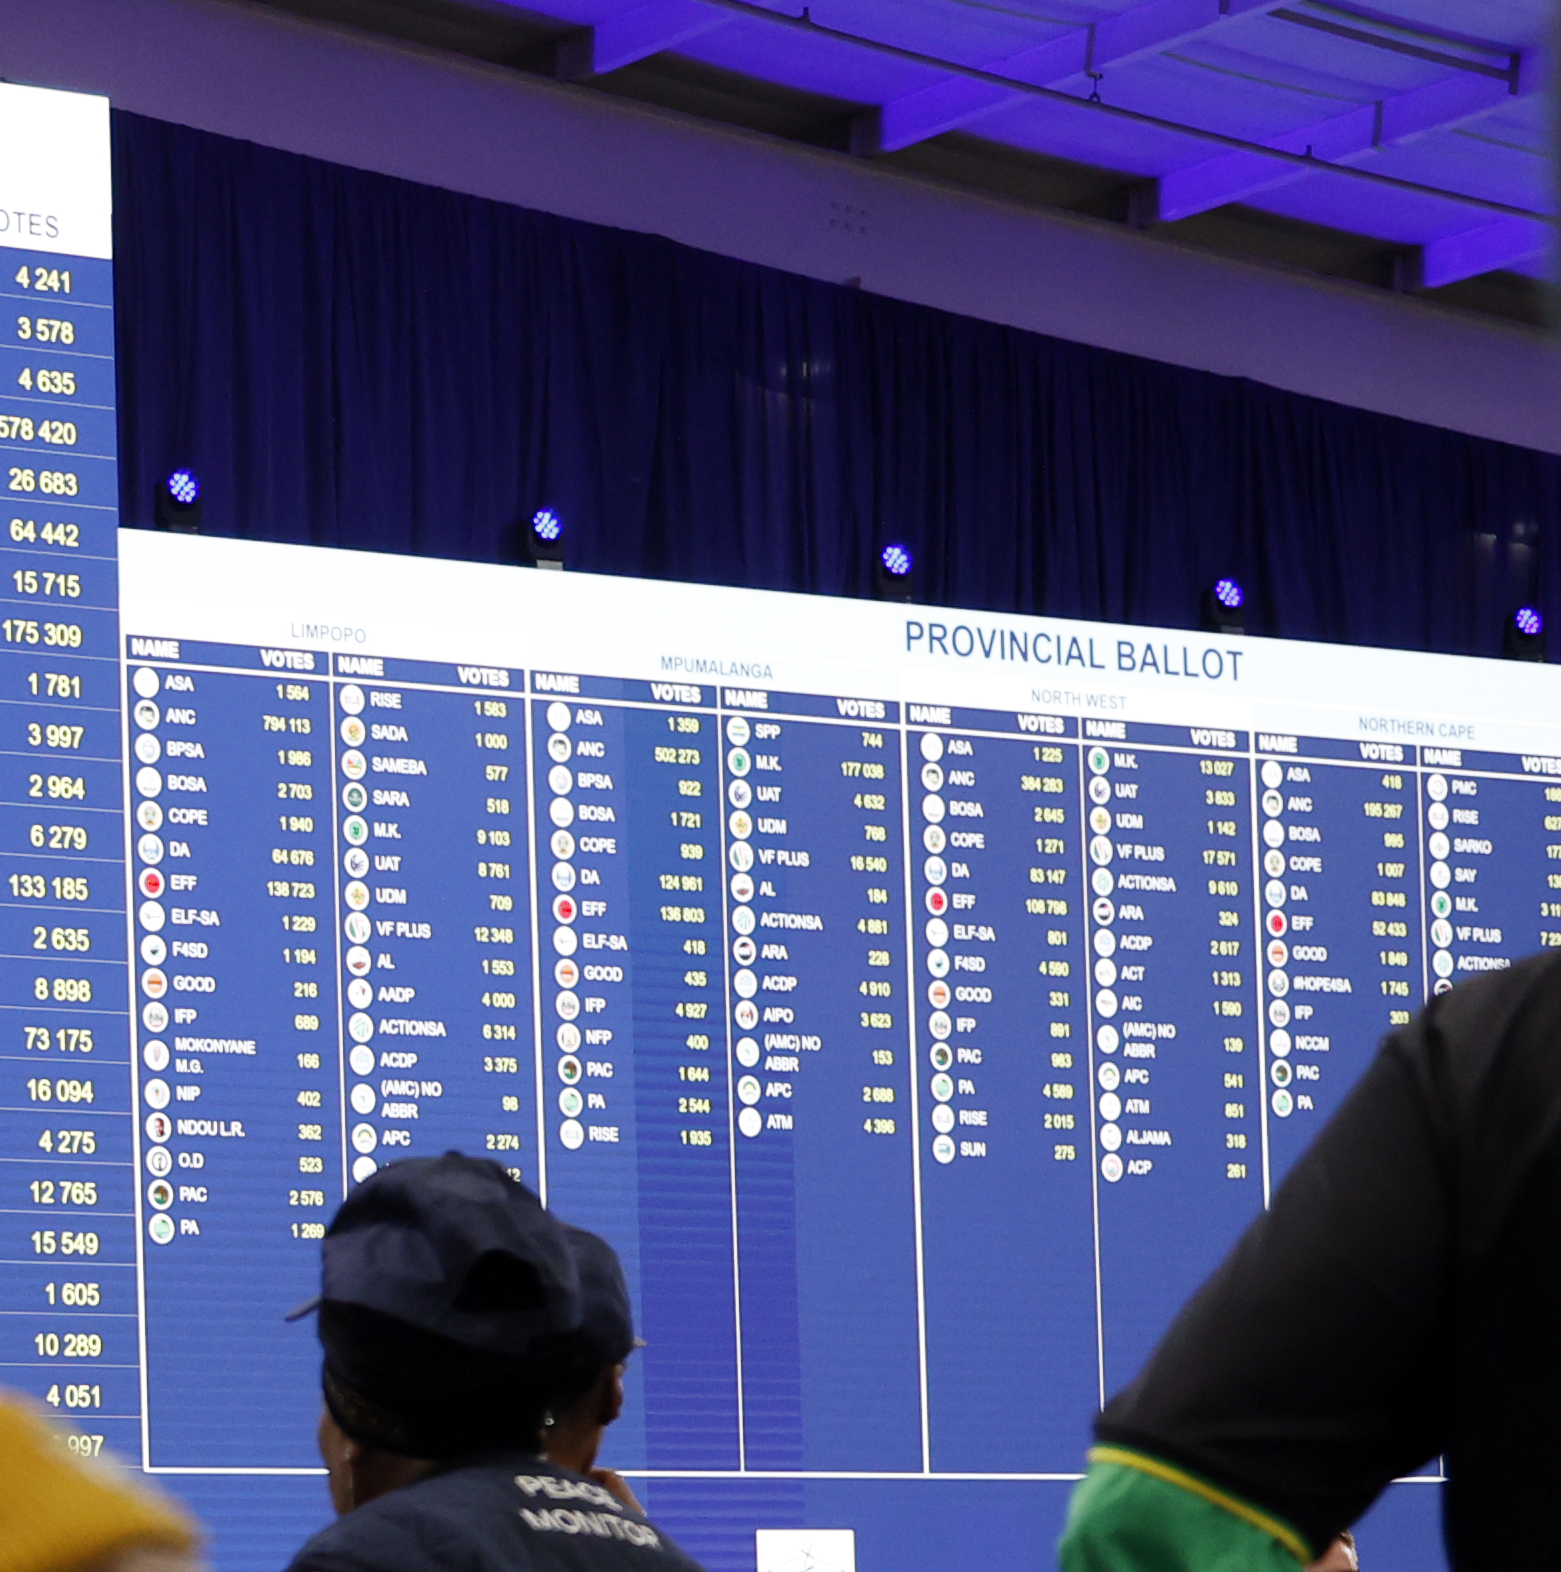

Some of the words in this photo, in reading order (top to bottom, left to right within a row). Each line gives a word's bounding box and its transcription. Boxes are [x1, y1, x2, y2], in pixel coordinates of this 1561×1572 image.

[36, 420, 76, 445] 420
[291, 623, 367, 644] LIMPOPO
[132, 638, 180, 660] NAME
[906, 621, 1105, 669] PROVINCIAL
[1117, 640, 1243, 681] BALLOT
[260, 649, 316, 671] VOTES
[337, 656, 385, 677] NAME
[661, 656, 773, 679] MPUMALANGA
[457, 666, 510, 687] VOTES
[1032, 690, 1080, 703] NORTH
[1087, 695, 1125, 707] WEST
[370, 724, 408, 741] SADA
[755, 724, 781, 740] SPP
[1359, 717, 1434, 736] NORTHERN
[1439, 724, 1474, 739] CAPE
[861, 732, 883, 748] 744
[166, 741, 205, 759] BPSA
[372, 756, 427, 775] SAMEBA
[1451, 781, 1478, 797] PMC
[949, 801, 984, 818] BOSA
[1453, 835, 1493, 857] SARKO
[9, 874, 46, 898] 133
[52, 877, 88, 901] 185
[953, 924, 996, 942] ELF-SA
[763, 1008, 794, 1024] AIPO
[175, 1037, 256, 1054] MOKONYANE
[175, 1084, 201, 1102] NIP
[297, 1091, 320, 1106] 402
[1054, 1145, 1075, 1161] 275
[519, 1508, 661, 1548] MONITOR
